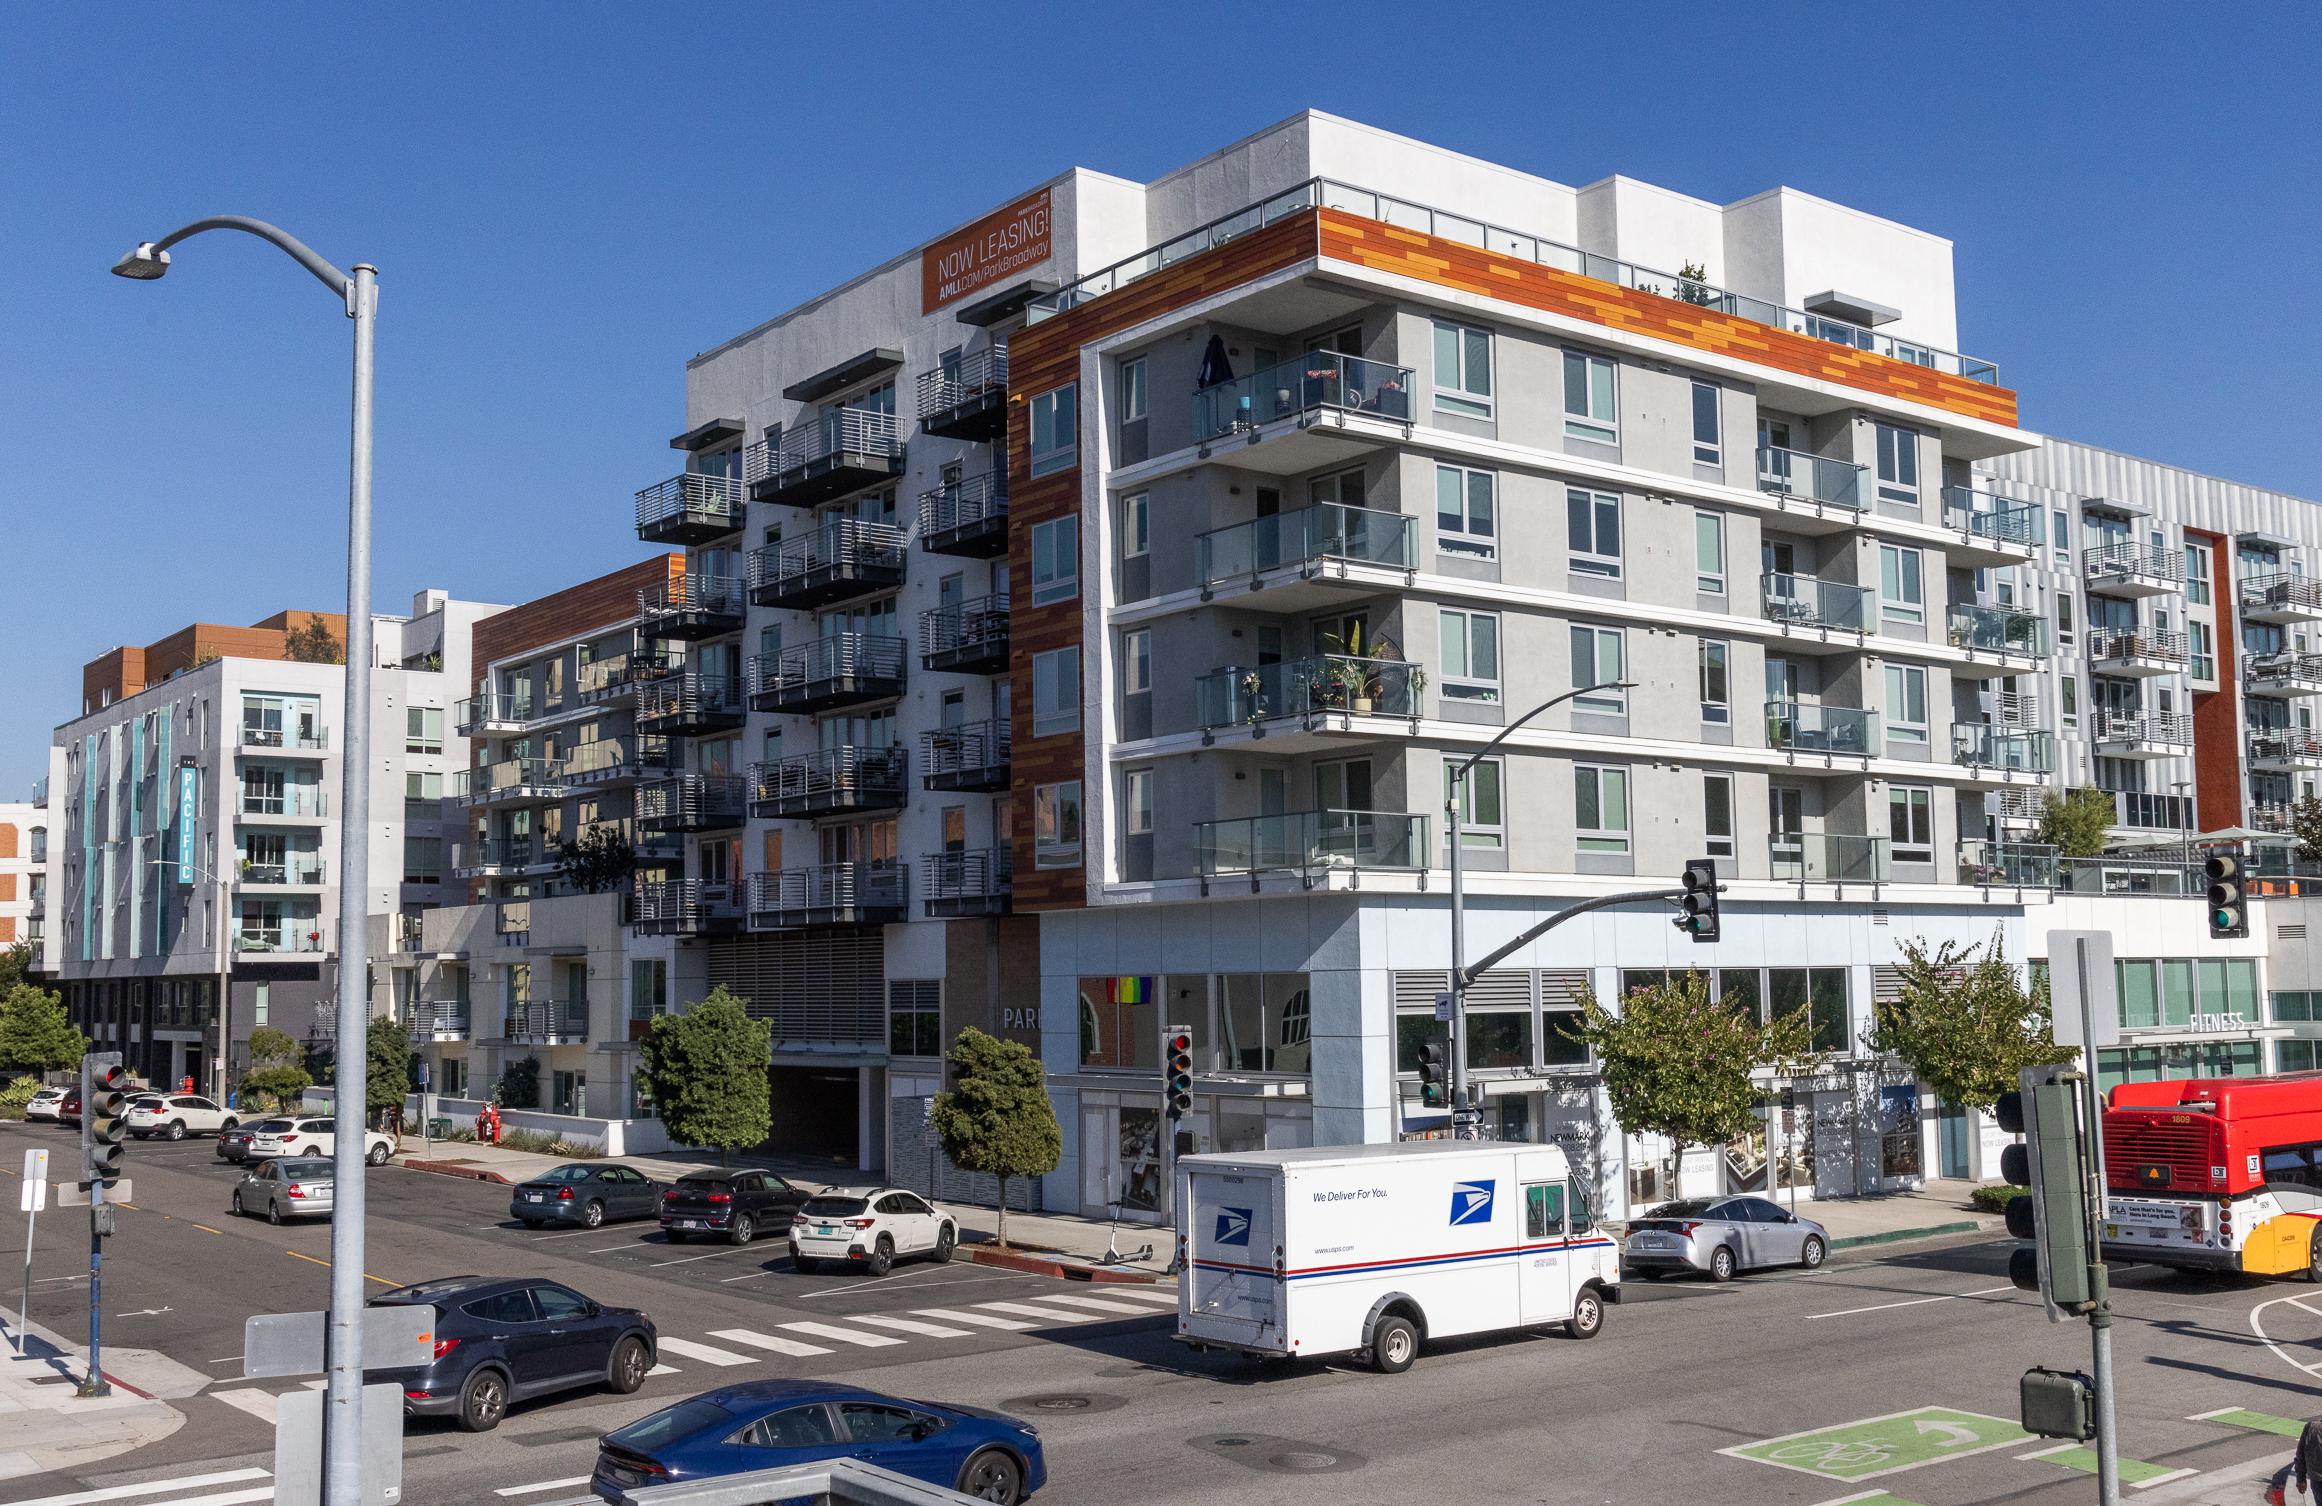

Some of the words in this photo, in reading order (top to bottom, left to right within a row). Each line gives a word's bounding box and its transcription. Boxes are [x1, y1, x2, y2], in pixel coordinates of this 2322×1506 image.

[939, 243, 974, 283] NOW
[979, 207, 1049, 263] LEASING!
[939, 240, 1049, 301] AMLI.COM/ParkBroadway
[182, 772, 193, 880] PACIFIC
[2189, 1011, 2246, 1033] FITNESS
[2172, 1115, 2191, 1124] 1809
[1550, 1131, 1590, 1143] NEWMARK
[1313, 1192, 1326, 1202] We
[1327, 1190, 1356, 1202] Deliver
[1357, 1189, 1371, 1199] For
[1371, 1187, 1388, 1198] You.
[1314, 1245, 1355, 1255] www.usps.com
